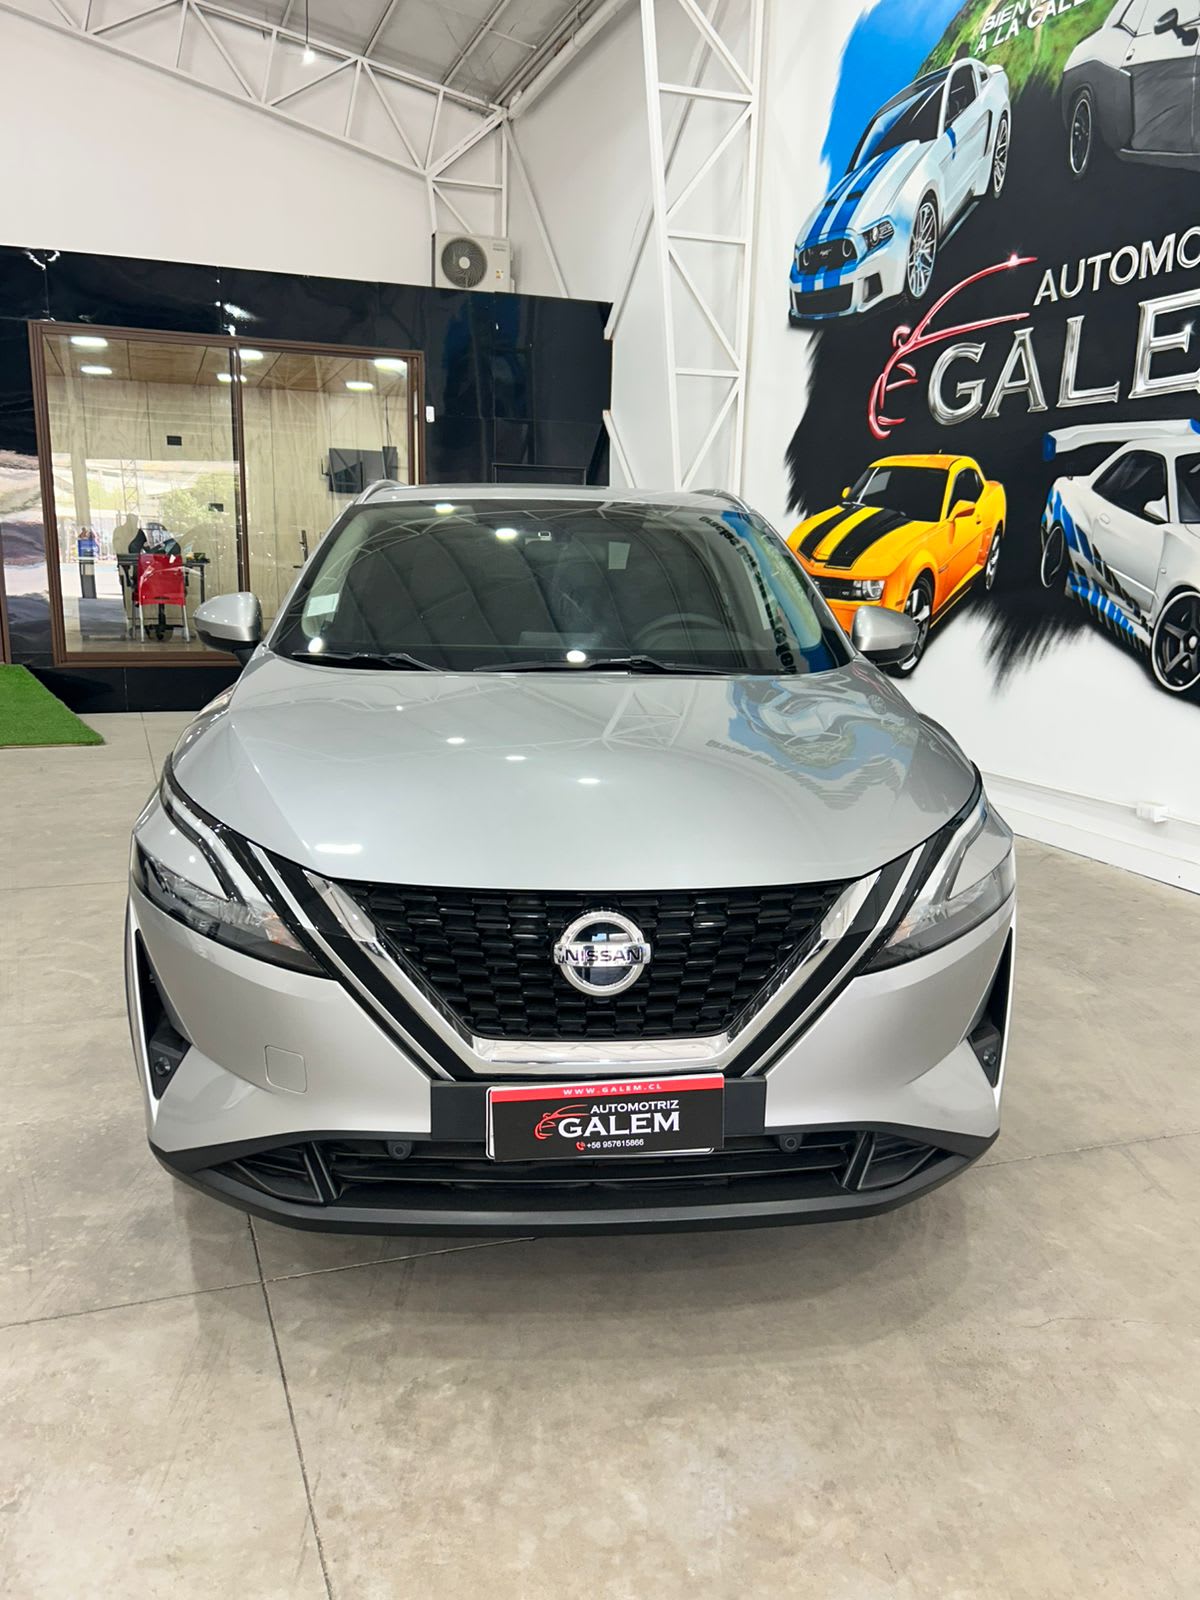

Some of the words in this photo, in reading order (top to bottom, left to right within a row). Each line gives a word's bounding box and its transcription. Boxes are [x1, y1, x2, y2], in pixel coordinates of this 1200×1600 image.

[974, 34, 988, 55] A
[992, 18, 1020, 47] LA
[928, 288, 1200, 426] GALE
[565, 946, 644, 962] NISSAN
[563, 1083, 662, 1096] WWW.GALEM.CL
[590, 1100, 680, 1114] AUTOMOTRIZ
[558, 1111, 680, 1138] GALEM
[586, 1141, 601, 1149] +56
